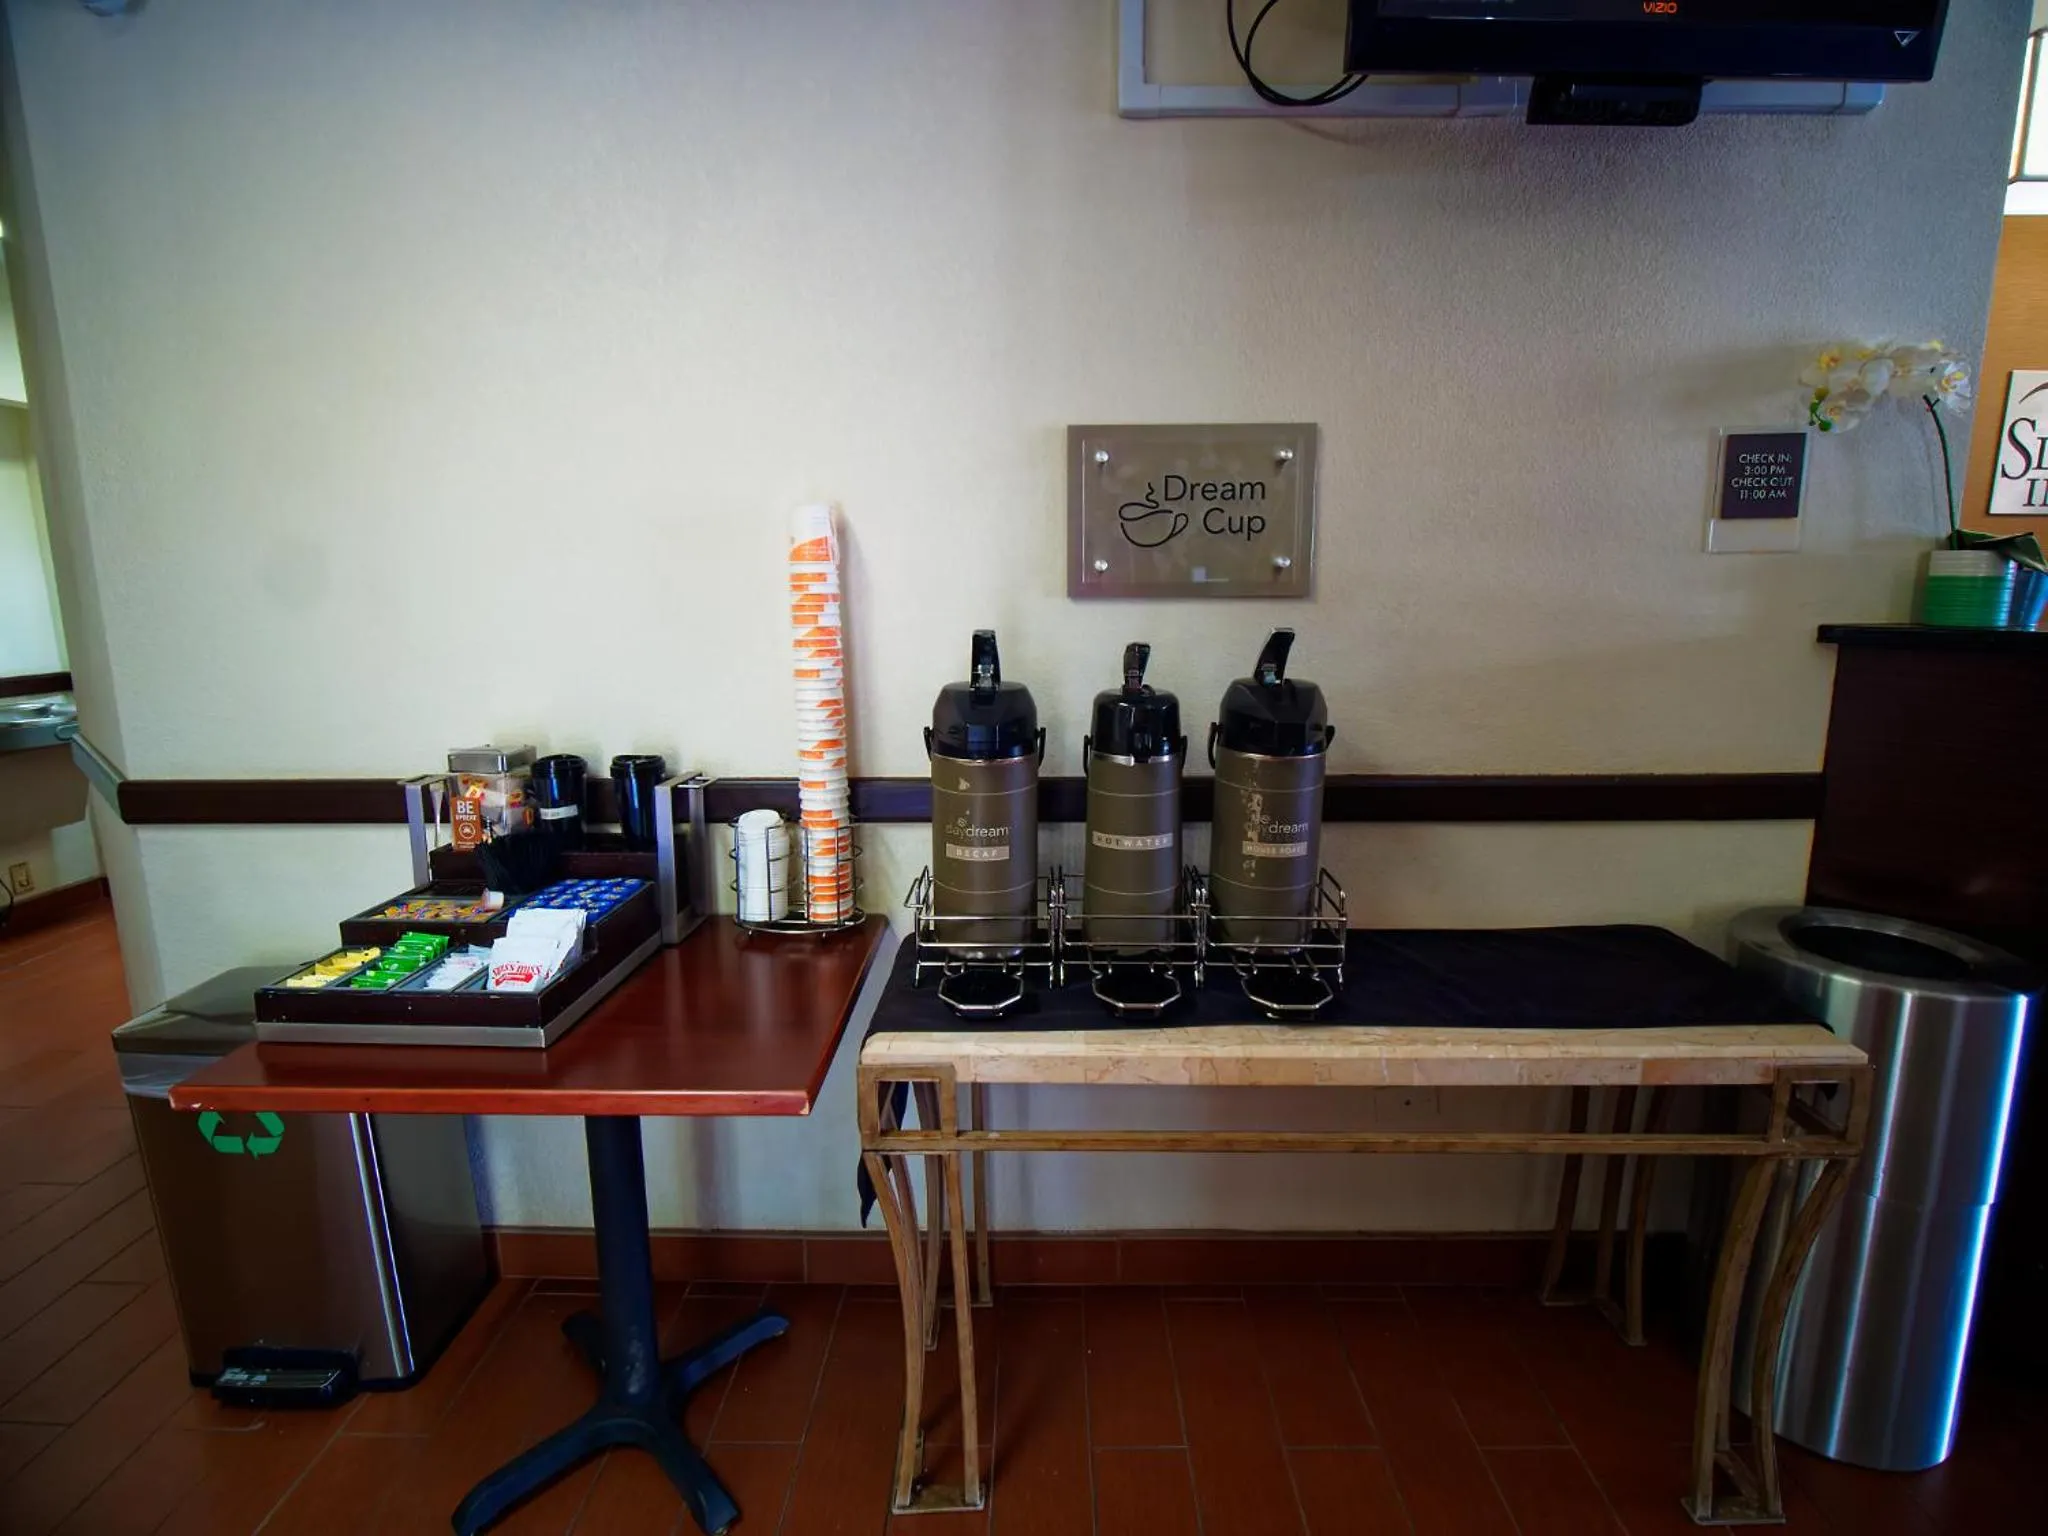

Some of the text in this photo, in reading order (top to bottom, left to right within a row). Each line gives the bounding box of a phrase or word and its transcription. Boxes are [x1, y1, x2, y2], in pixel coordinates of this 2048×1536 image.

[1643, 2, 1678, 14] VIZIO
[1738, 453, 1775, 464] CHECK
[1744, 464, 1786, 476] 3:00 PM
[1164, 474, 1266, 501] Dream
[1731, 477, 1767, 488] CHECK
[1740, 489, 1786, 500] 11:00 AM
[1202, 506, 1266, 541] Cup
[456, 800, 474, 814] BE
[956, 847, 998, 858] DECAF
